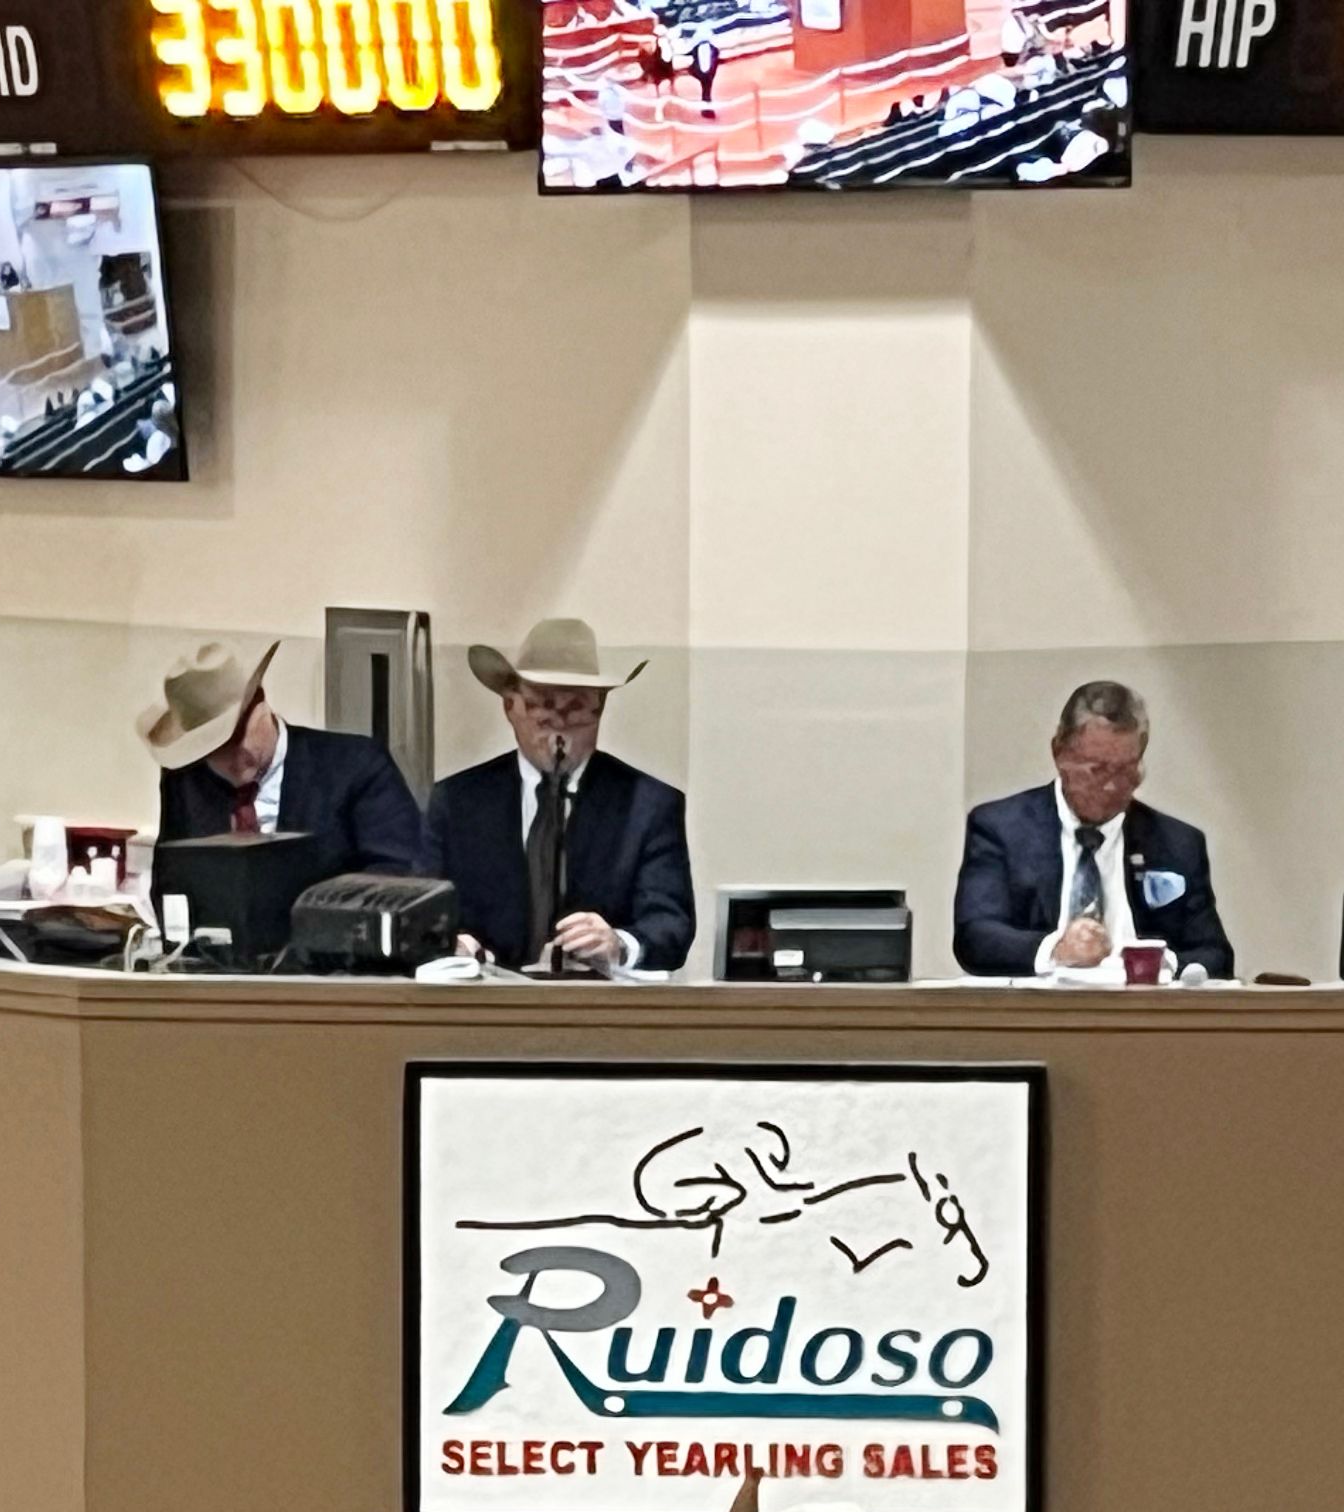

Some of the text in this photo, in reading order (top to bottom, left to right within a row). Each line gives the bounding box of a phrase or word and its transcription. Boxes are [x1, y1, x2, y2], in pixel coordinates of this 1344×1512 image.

[151, 0, 502, 117] 330000
[1174, 0, 1276, 68] HIP
[441, 1245, 996, 1418] Ruidoso
[441, 1440, 999, 1480] SELECT YEARLING SALES
